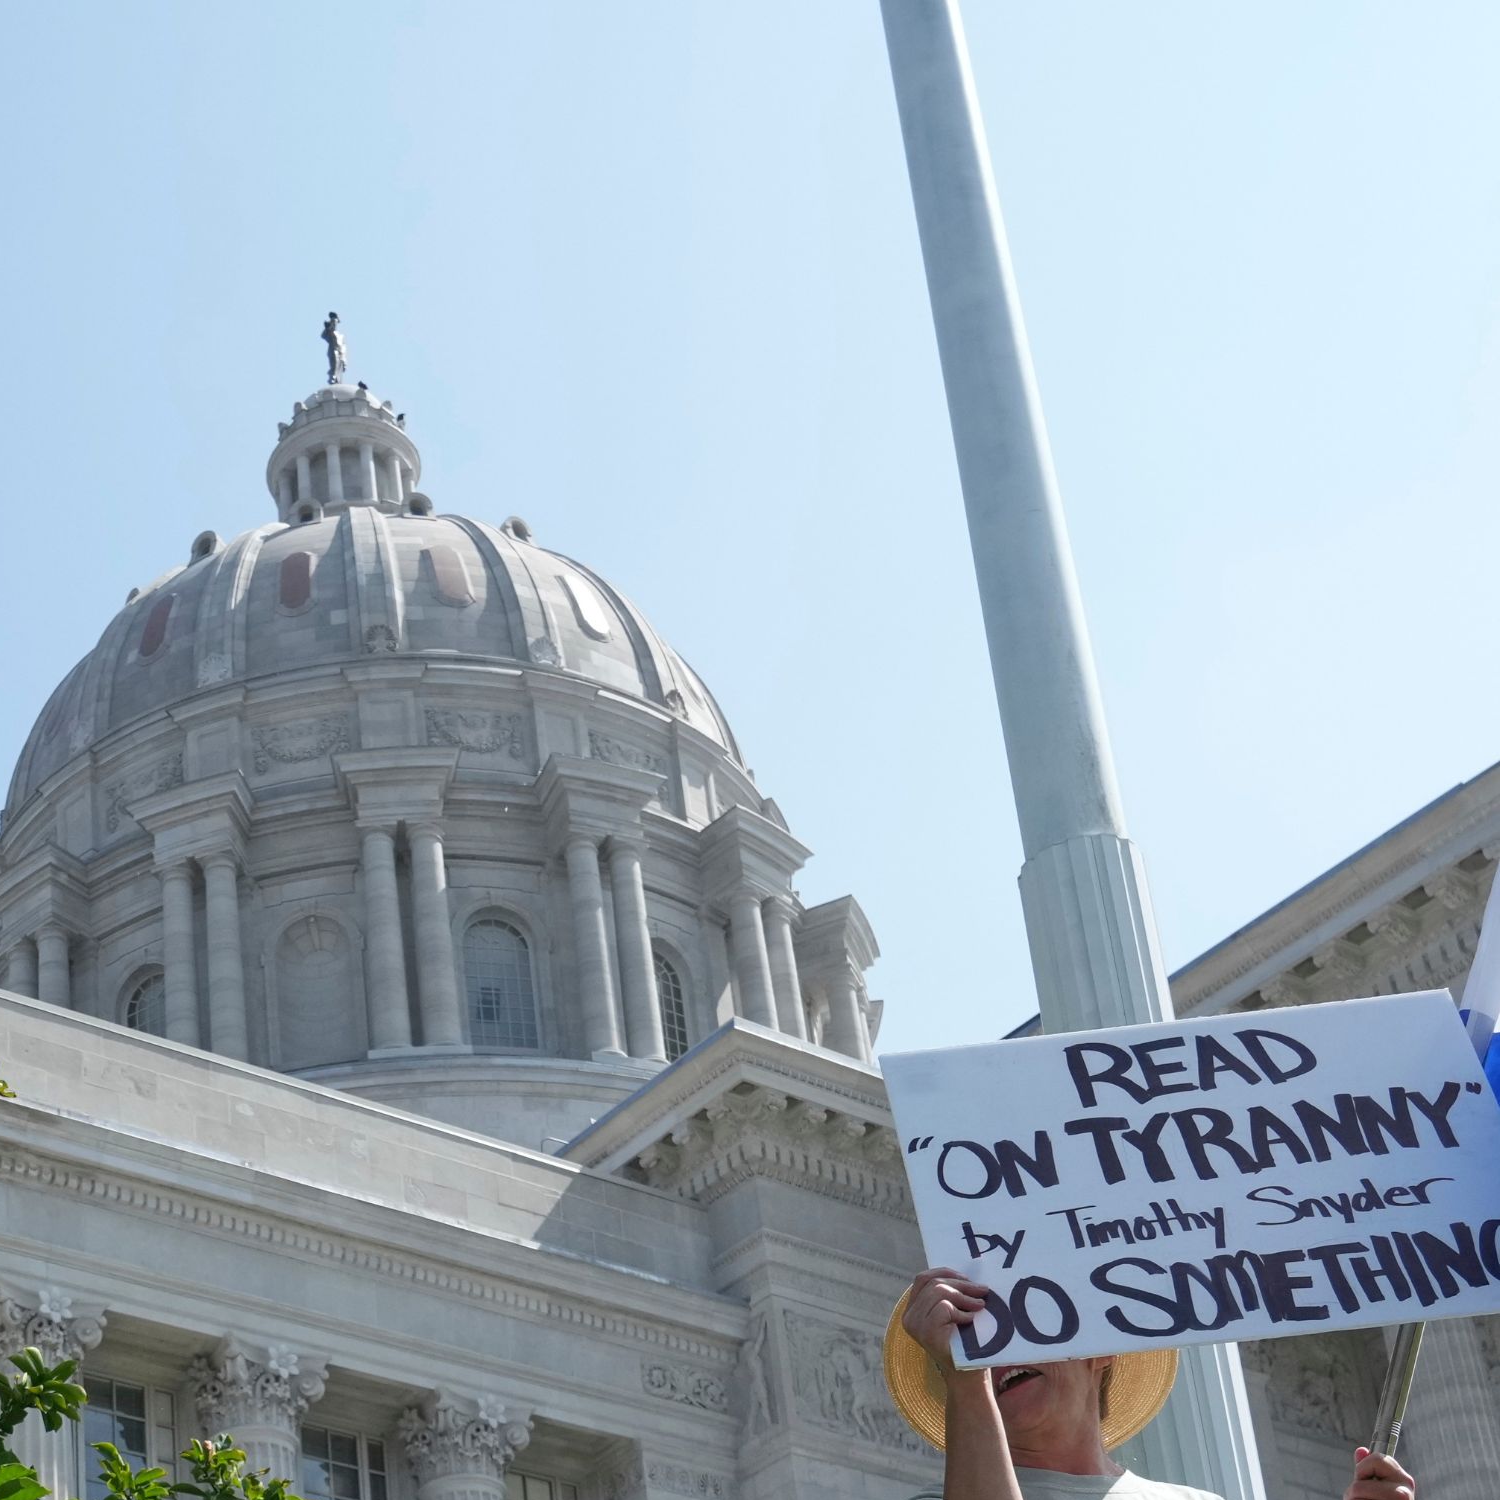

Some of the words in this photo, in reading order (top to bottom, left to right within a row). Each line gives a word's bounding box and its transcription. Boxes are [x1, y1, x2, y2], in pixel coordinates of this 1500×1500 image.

[1064, 1029, 1317, 1108] READ
[907, 1130, 1059, 1200] "ON
[1065, 1081, 1482, 1186] TYRANNY"
[961, 1221, 1025, 1269] by
[1046, 1198, 1227, 1250] Timothy
[1246, 1177, 1455, 1229] Snyder
[955, 1275, 1080, 1362] DO
